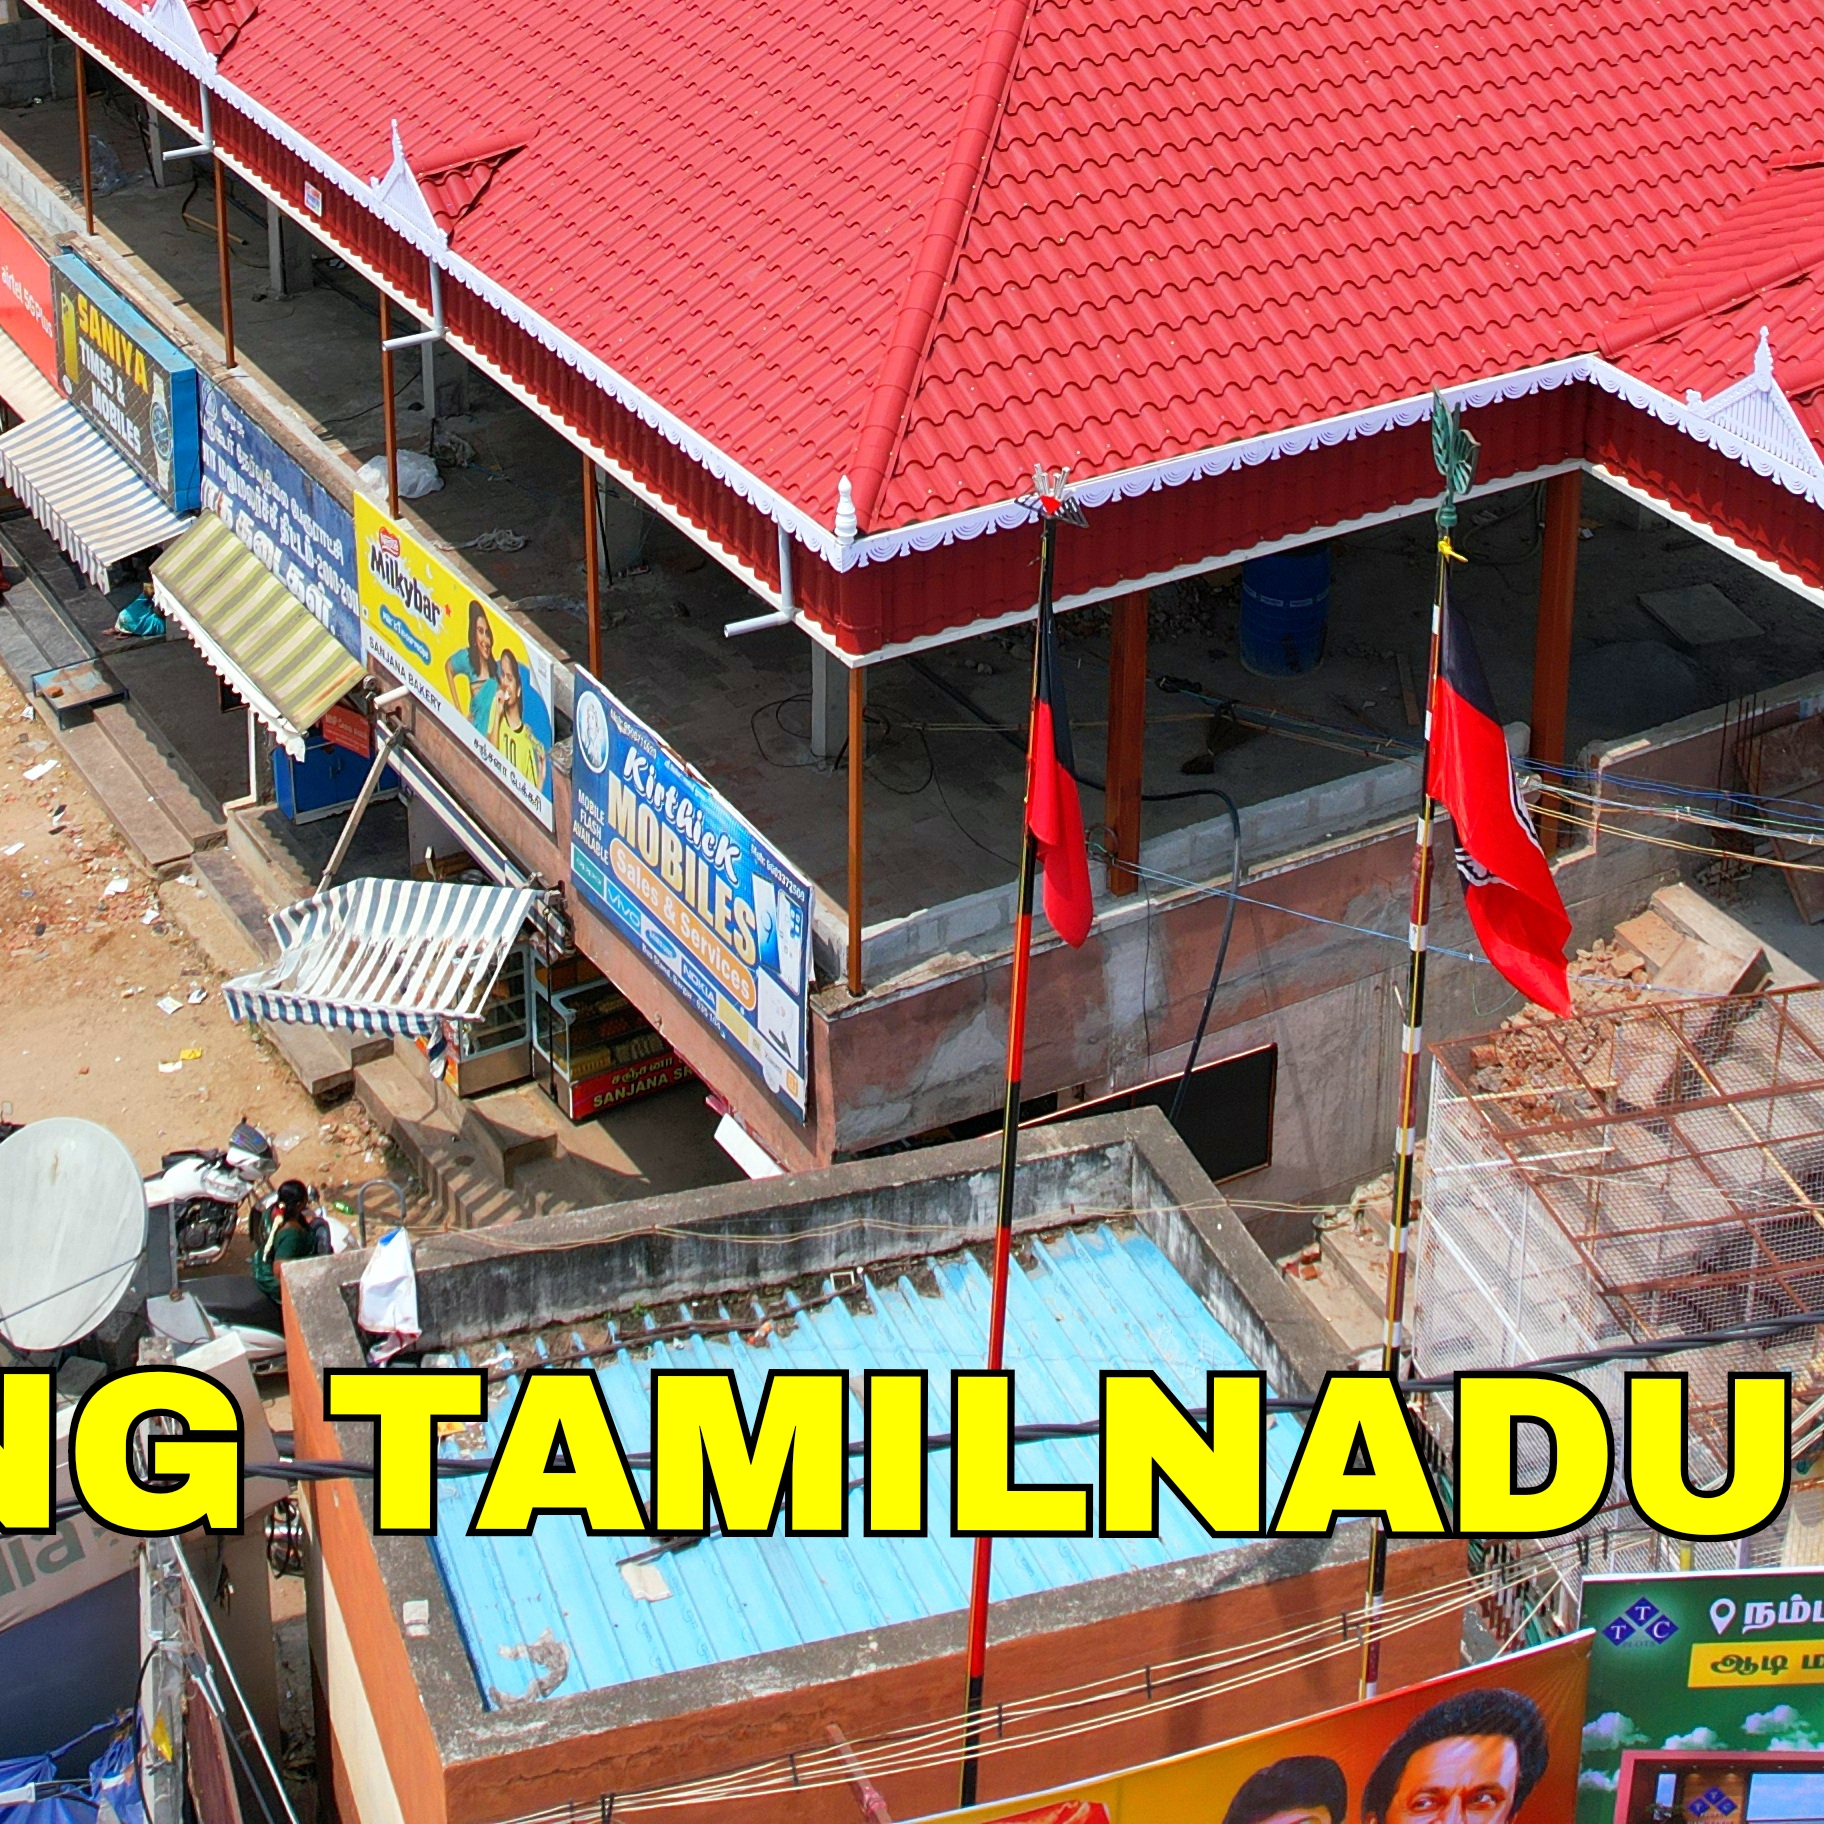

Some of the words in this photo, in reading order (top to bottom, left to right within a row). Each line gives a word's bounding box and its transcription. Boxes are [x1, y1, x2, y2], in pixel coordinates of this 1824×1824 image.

[1, 266, 22, 302] airtel
[78, 293, 148, 394] SANIYA
[79, 337, 114, 395] TIMES
[116, 375, 125, 407] &
[91, 382, 140, 455] MOBILES
[370, 545, 441, 628] Milkybar
[369, 636, 407, 680] SANJANA
[407, 673, 442, 712] BAKERY
[578, 789, 605, 826] MOBILE
[580, 809, 601, 840] FLASH
[573, 819, 609, 866] AVAILABLE
[607, 770, 756, 965] MOBILES
[616, 845, 659, 907] Sales
[664, 898, 677, 923] &
[680, 912, 750, 1002] Services
[682, 963, 716, 1004] NOKIA
[593, 1073, 668, 1108] SANJANA
[1710, 1650, 1789, 1675] ஆடி
